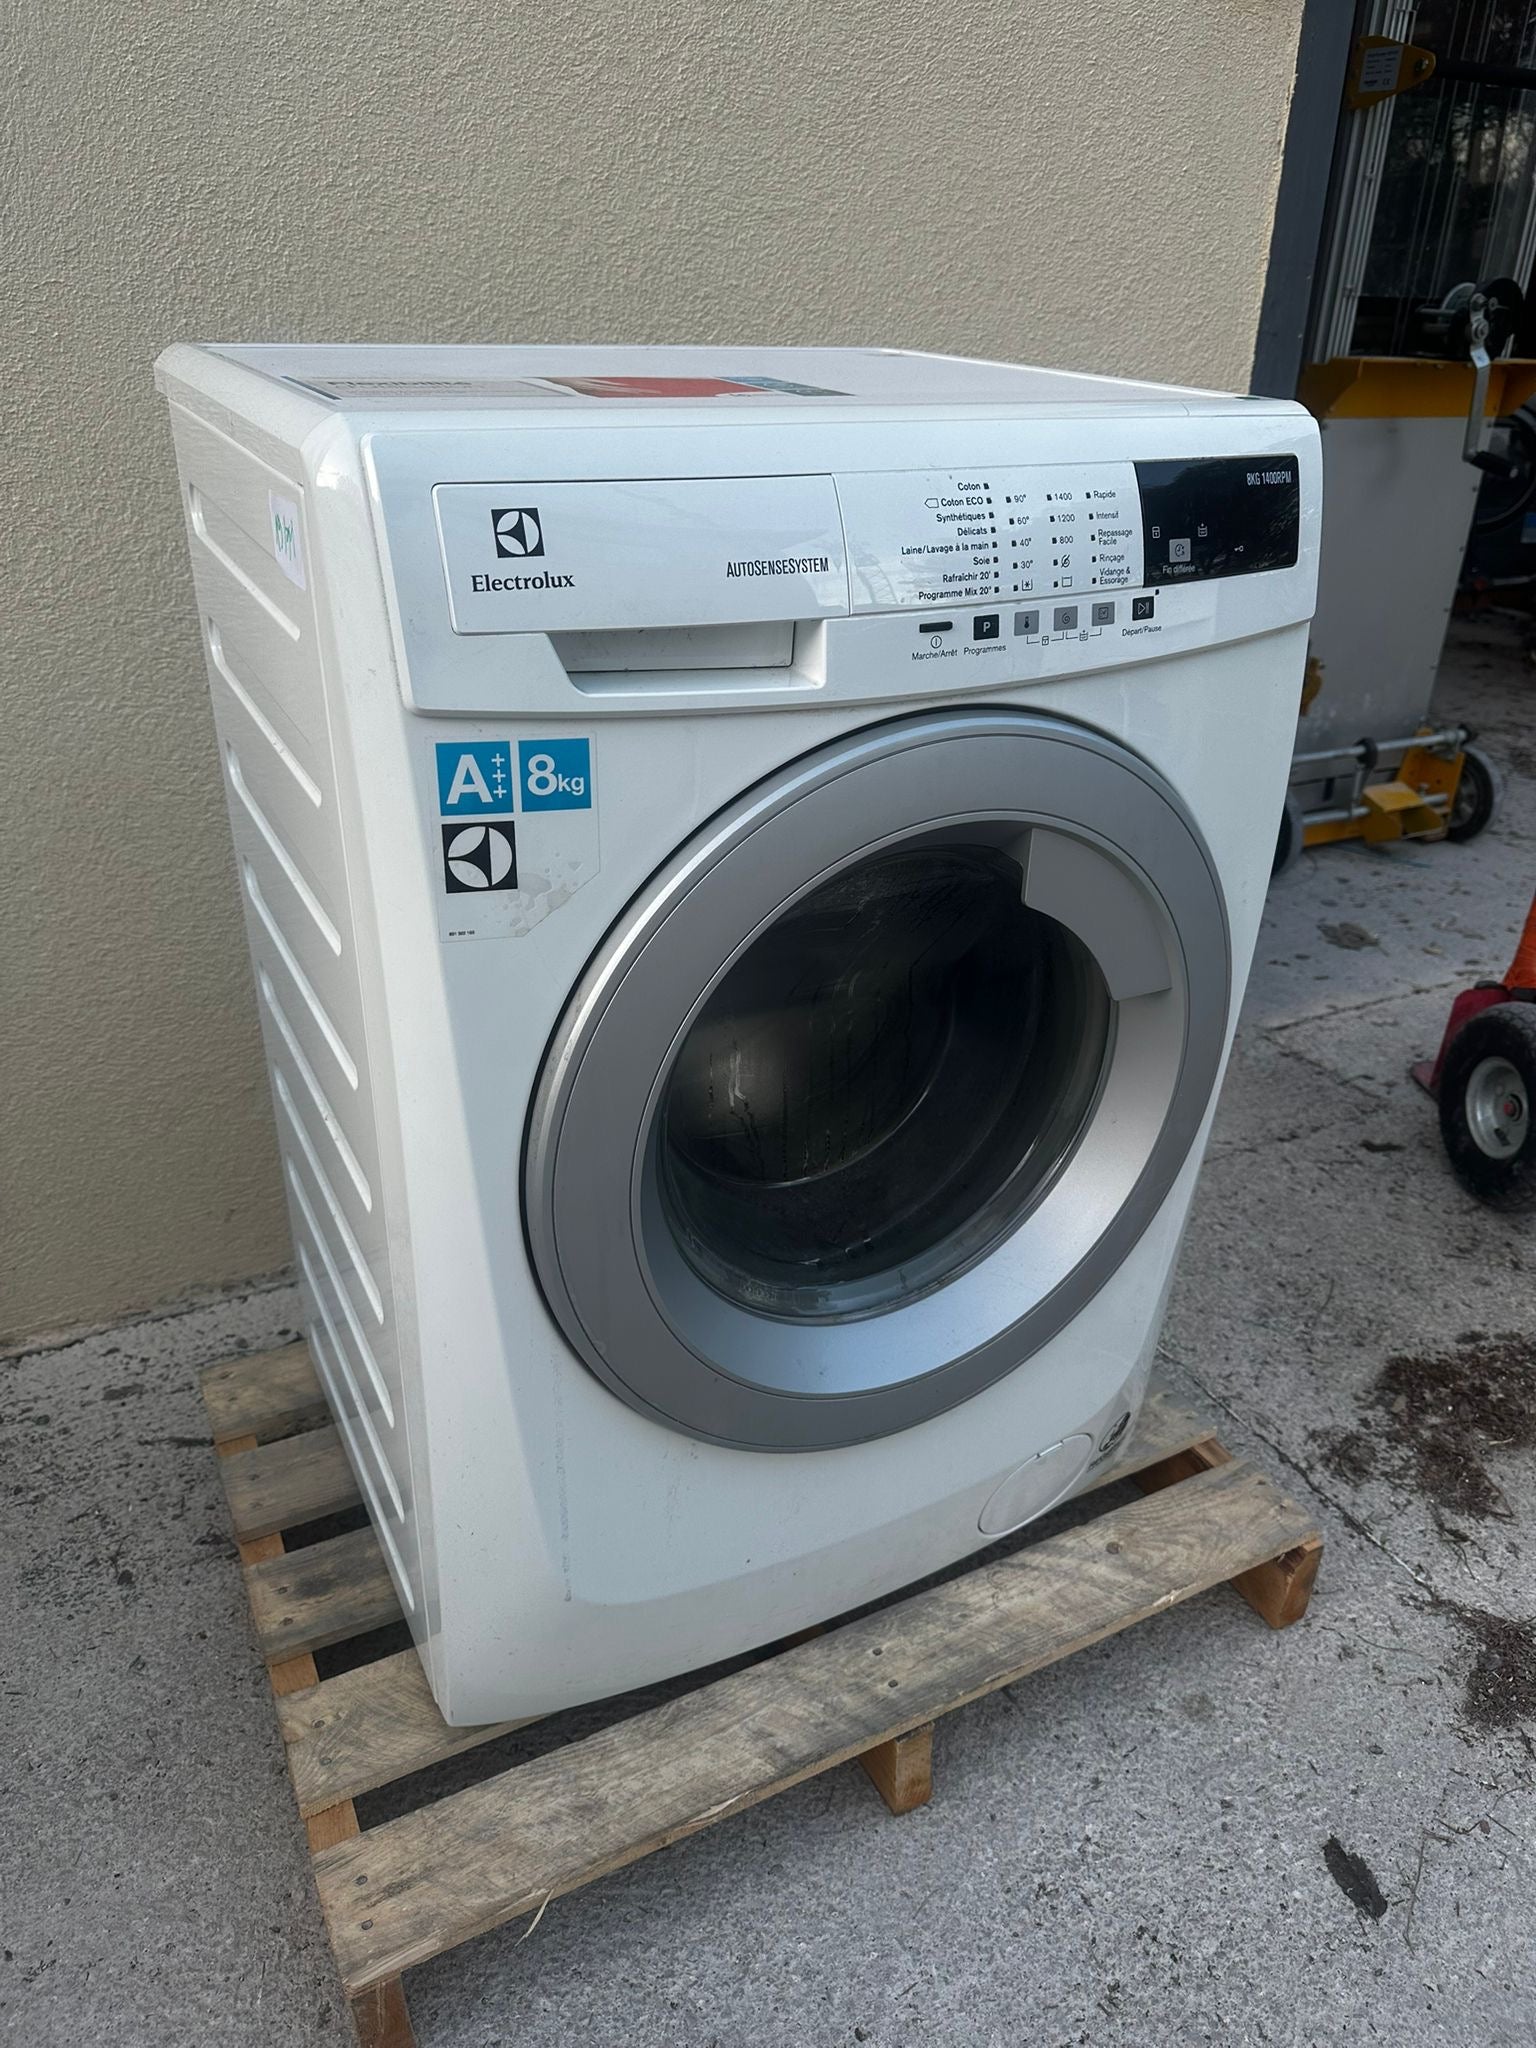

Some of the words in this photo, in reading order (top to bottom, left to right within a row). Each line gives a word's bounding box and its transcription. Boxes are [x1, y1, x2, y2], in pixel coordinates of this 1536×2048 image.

[1246, 472, 1260, 486] 8KG
[1261, 470, 1292, 485] 1400RPM
[957, 482, 981, 491] Coton
[1014, 494, 1027, 503] 90°
[1054, 493, 1073, 501] 1400
[1093, 489, 1116, 499] Rapide
[941, 497, 964, 507] Coton
[966, 496, 984, 506] ECO
[936, 512, 986, 523] Synthétiques
[1057, 514, 1076, 523] 1200
[1096, 510, 1119, 520] Intensif
[1017, 516, 1030, 525] 60°
[957, 527, 988, 537] Délicats
[1098, 528, 1133, 539] Repassage
[1019, 537, 1032, 547] 40°
[1059, 536, 1074, 544] 800
[1098, 537, 1118, 546] Facile
[901, 544, 954, 555] Laine/Lavage
[955, 543, 961, 552] à
[962, 543, 969, 551] la
[970, 542, 989, 551] main
[972, 556, 991, 566] Soie
[1099, 553, 1125, 563] Rinçage
[1020, 560, 1034, 569] 30°
[1099, 567, 1125, 577] Vidange
[1125, 567, 1131, 575] &
[471, 571, 575, 593] Electrolux
[942, 572, 978, 583] Rafraîchir
[1099, 576, 1129, 586] Essorage
[918, 590, 963, 601] Programme
[964, 588, 978, 597] Mix
[983, 621, 992, 633] P
[1122, 624, 1162, 637] Départ/Pause
[911, 648, 958, 661] Marche/Arrêt
[963, 644, 1007, 656] Programmes
